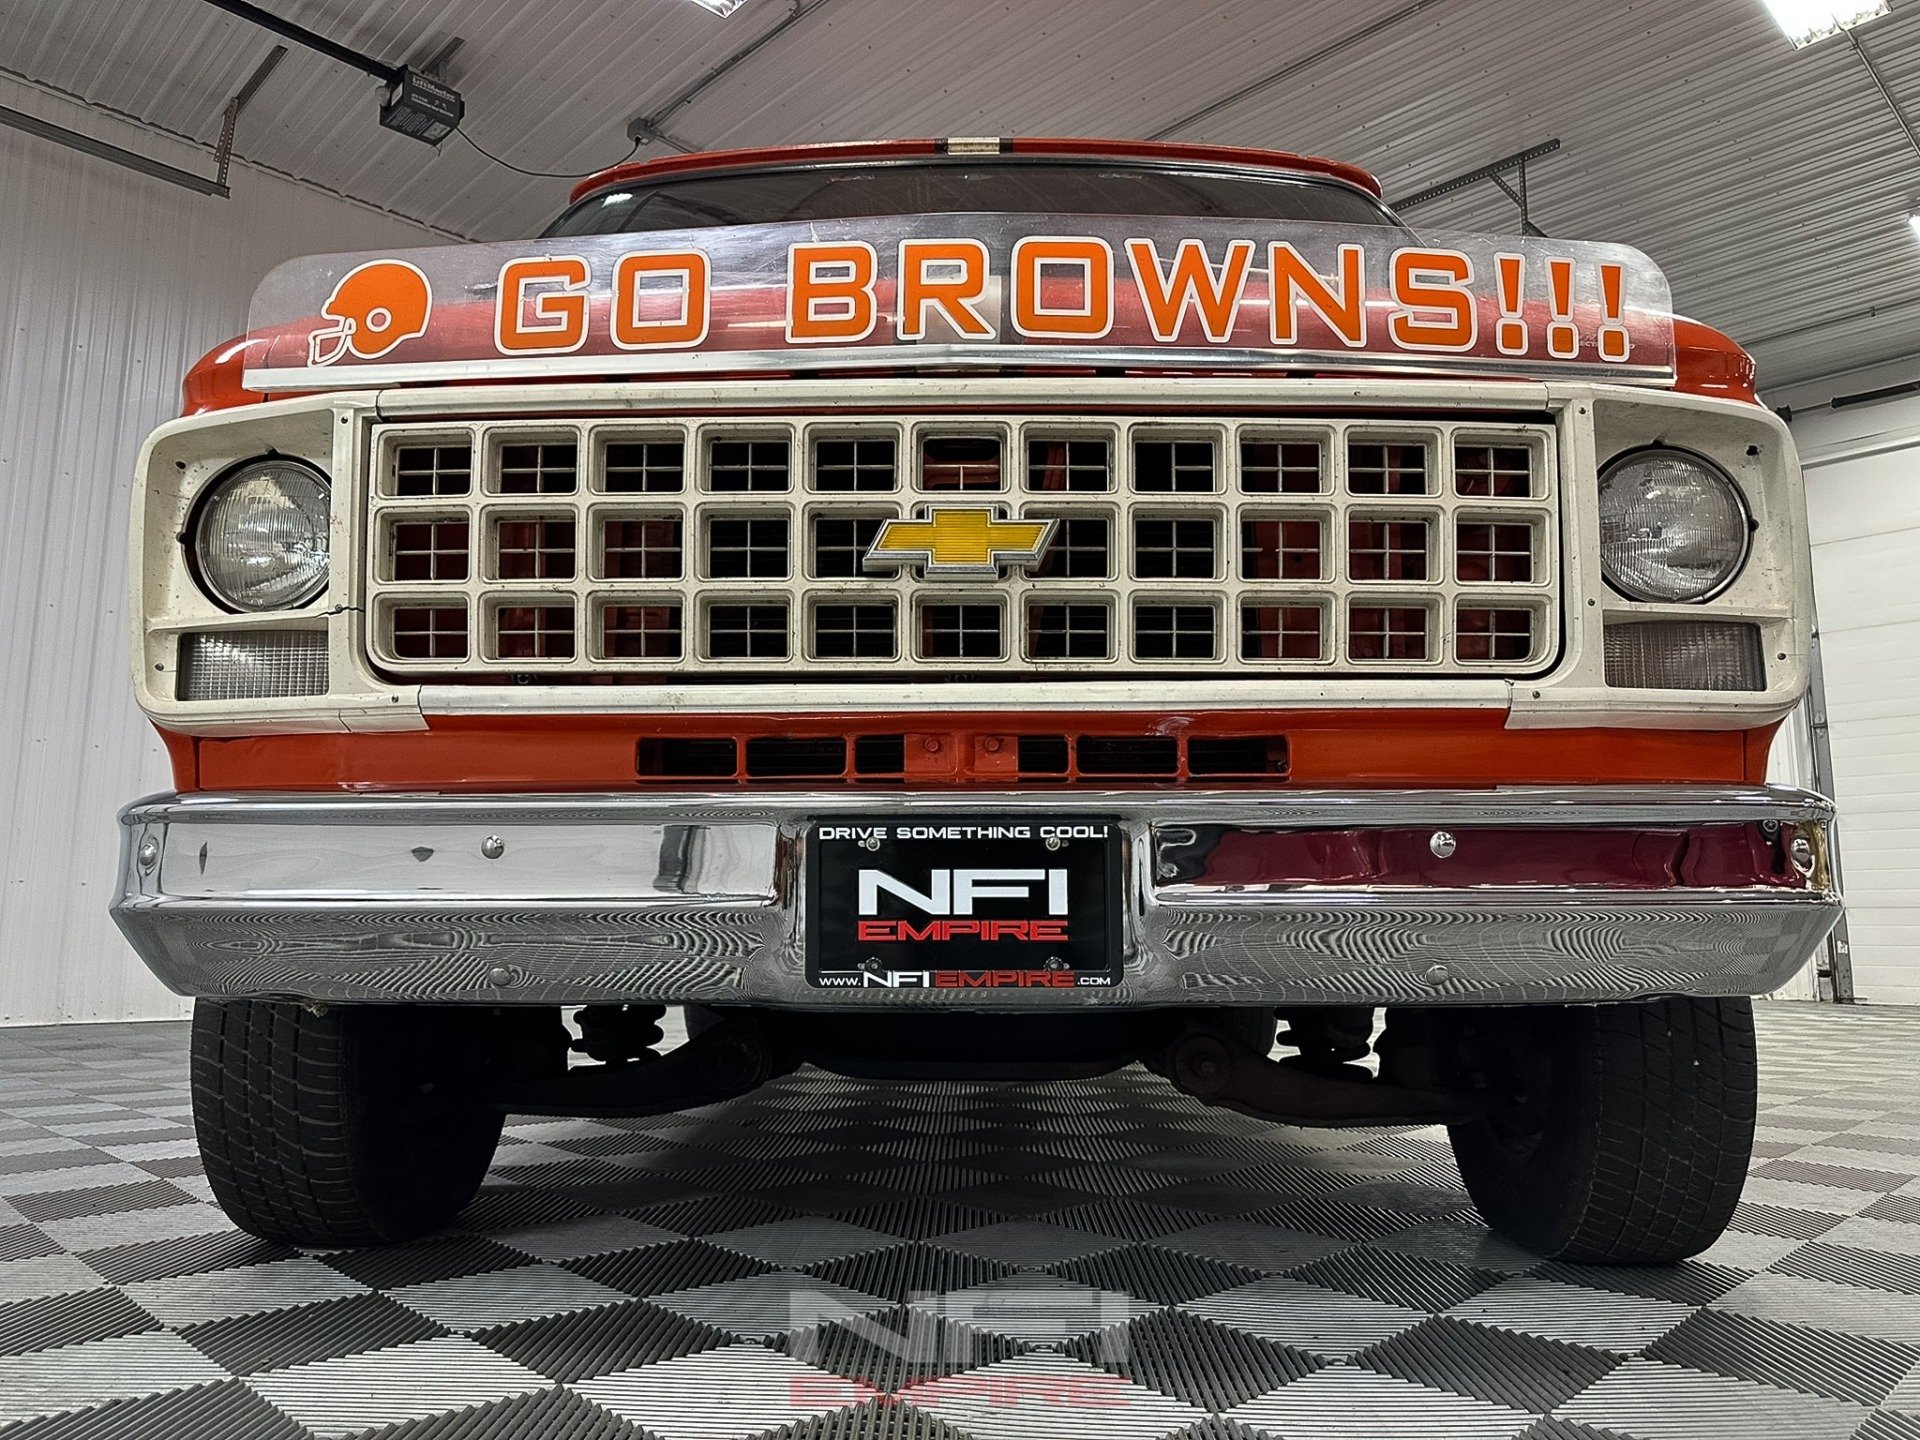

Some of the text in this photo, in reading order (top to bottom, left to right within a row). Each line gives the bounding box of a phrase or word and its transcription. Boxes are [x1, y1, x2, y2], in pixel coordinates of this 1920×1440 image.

[494, 236, 1630, 362] GO BROWNS!!!
[819, 826, 1108, 840] DRIVE SOMETHING COOL!
[858, 869, 1068, 915] NFI
[858, 920, 1068, 941] EMPIRE
